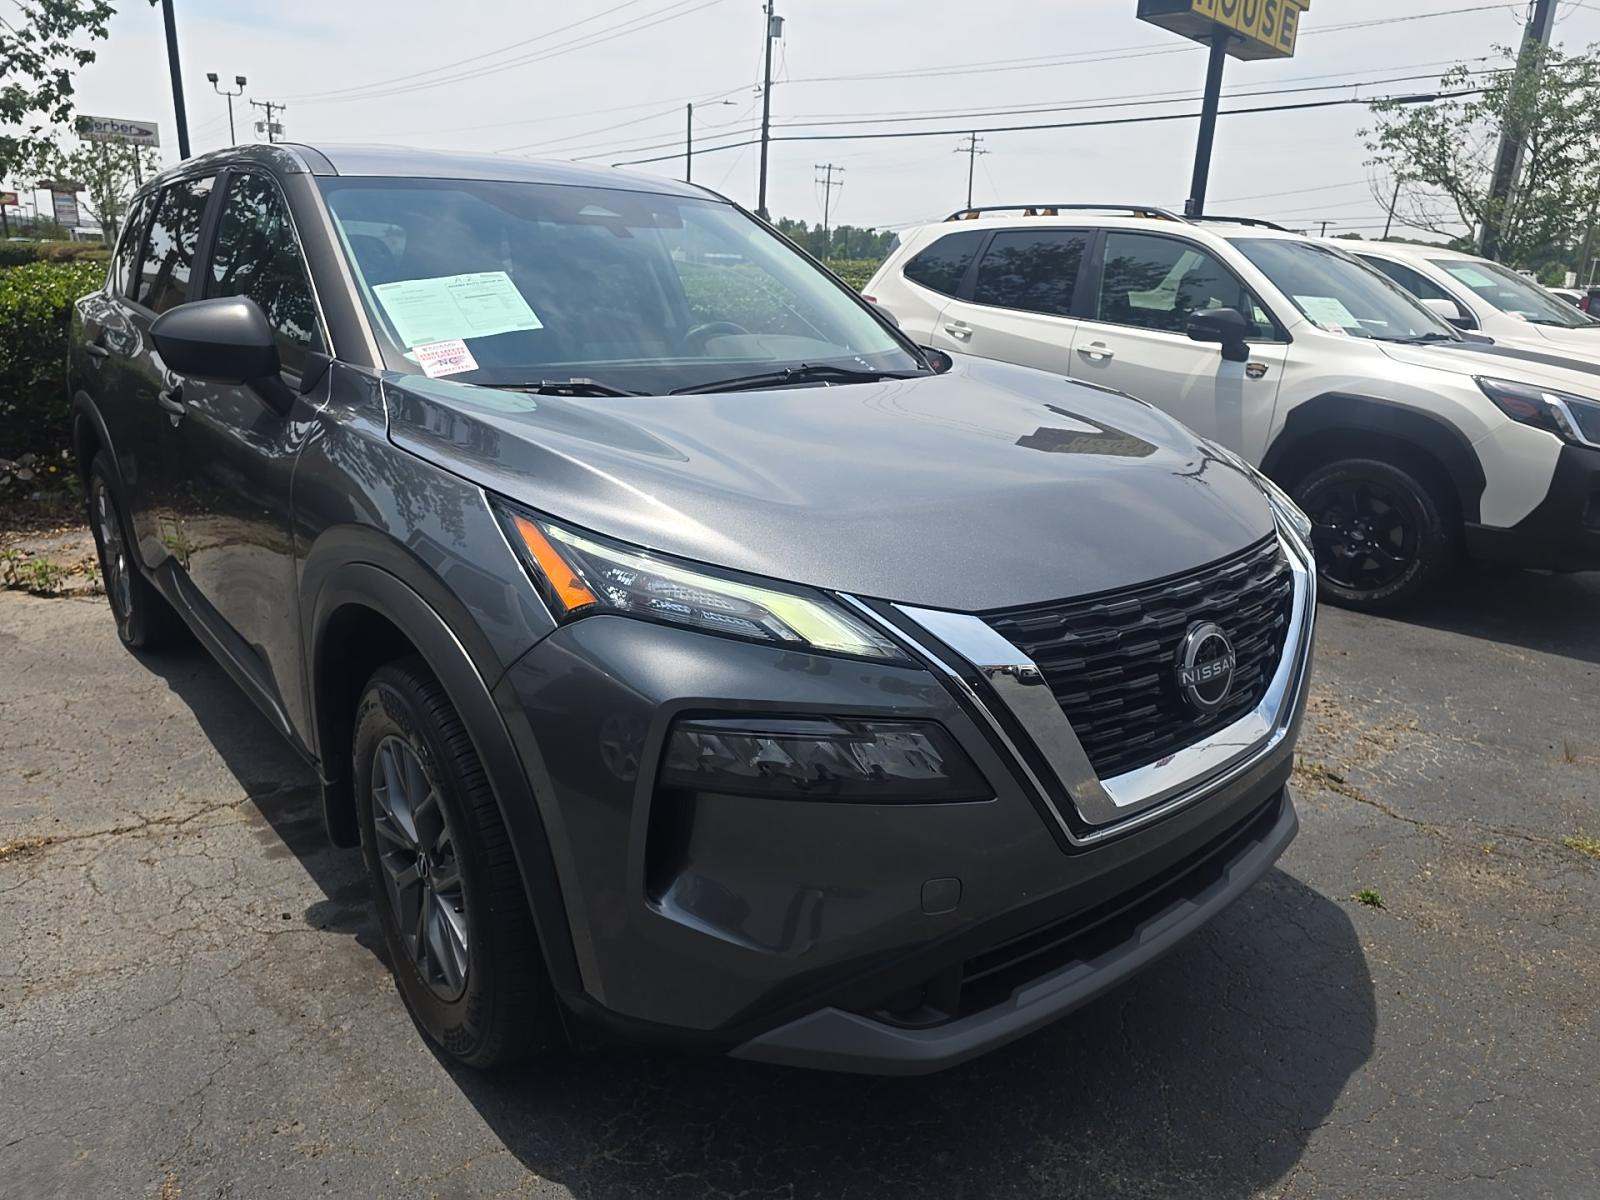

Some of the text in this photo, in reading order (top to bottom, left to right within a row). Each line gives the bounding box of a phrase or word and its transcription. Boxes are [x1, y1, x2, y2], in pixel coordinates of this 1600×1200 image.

[1196, 0, 1296, 46] OUSE
[84, 119, 136, 135] erber
[1182, 655, 1236, 684] NISSAN
